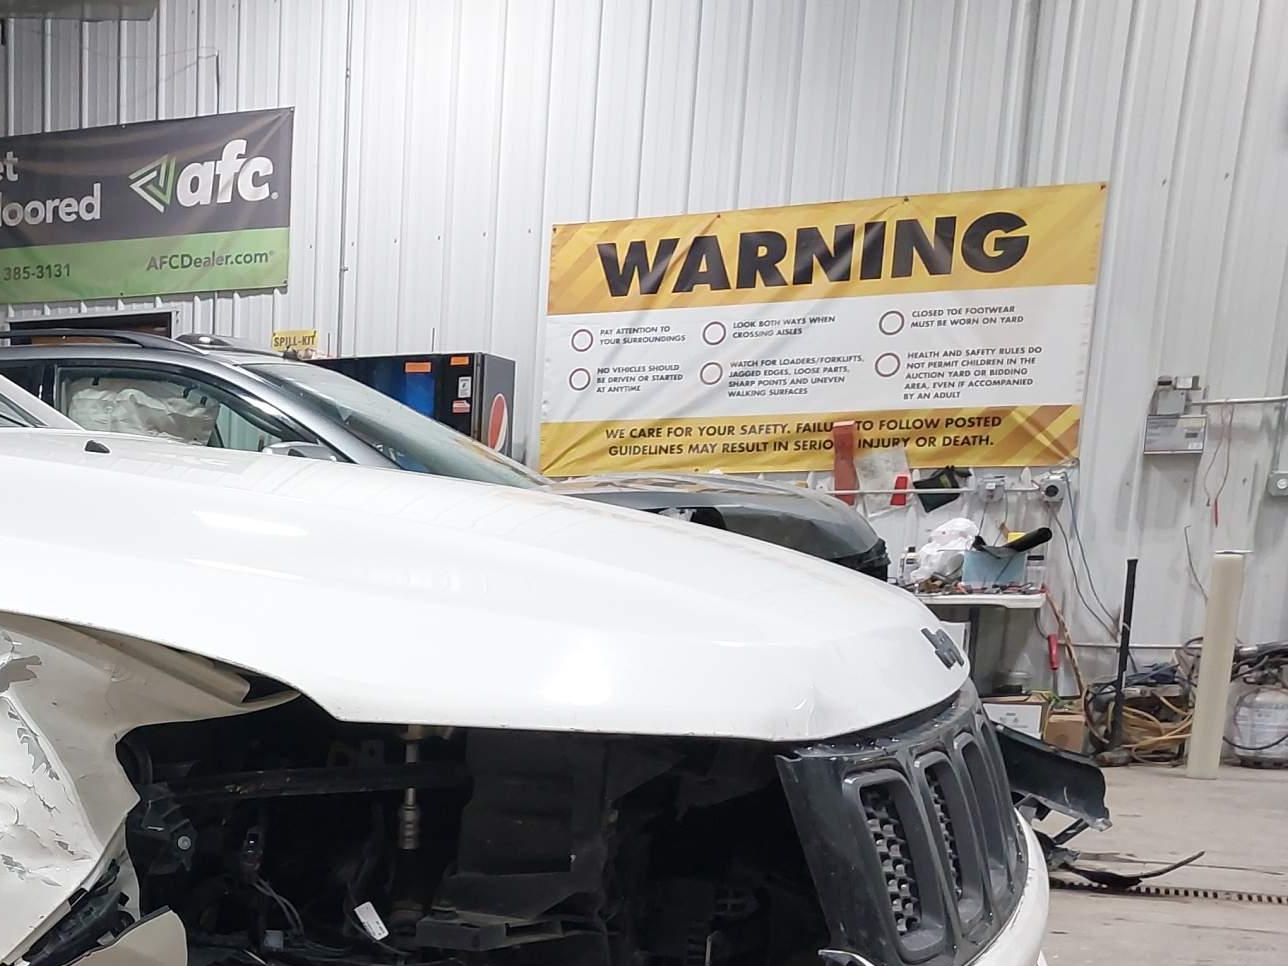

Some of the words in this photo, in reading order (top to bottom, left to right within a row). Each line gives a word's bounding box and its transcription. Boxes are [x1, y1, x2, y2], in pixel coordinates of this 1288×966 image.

[597, 211, 1030, 297] WARNING
[3, 263, 71, 282] 385-3131
[965, 306, 1014, 314] FOOTWEAR
[911, 320, 934, 328] MUST
[1000, 315, 1023, 323] YARD
[733, 330, 774, 338] CROSSING
[776, 328, 802, 336] AISLES
[273, 335, 316, 347] SPILL-KIT
[623, 335, 686, 344] SURROUNDINGS
[730, 360, 758, 368] WATCH
[928, 360, 958, 368] PERMIT
[962, 359, 1003, 367] CHILDREN
[729, 370, 761, 378] JAGGED
[794, 367, 819, 375] LOOSE
[906, 372, 944, 380] AUCTION
[948, 370, 970, 378] YARD
[990, 368, 1028, 376] BIDDING
[811, 376, 844, 384] UNEVEN
[968, 379, 1033, 387] ACCOMPANIED
[728, 389, 766, 397] WALKING
[605, 429, 625, 439] WE
[629, 428, 662, 438] CARE
[667, 427, 692, 437] FOR
[697, 426, 735, 436] YOUR
[740, 424, 790, 435] SAFETY.
[796, 421, 833, 433] FAILU
[855, 420, 873, 431] TO
[879, 418, 943, 430] FOLLOW
[945, 417, 1001, 428] POSTED
[609, 444, 683, 456] GUIDELINES
[688, 444, 717, 454] MAY
[722, 442, 768, 453] RESULT
[773, 441, 788, 451] IN
[793, 439, 833, 450] SERIO
[857, 437, 910, 448] INJURY
[916, 437, 935, 447] OR
[942, 435, 993, 446] DEATH.
